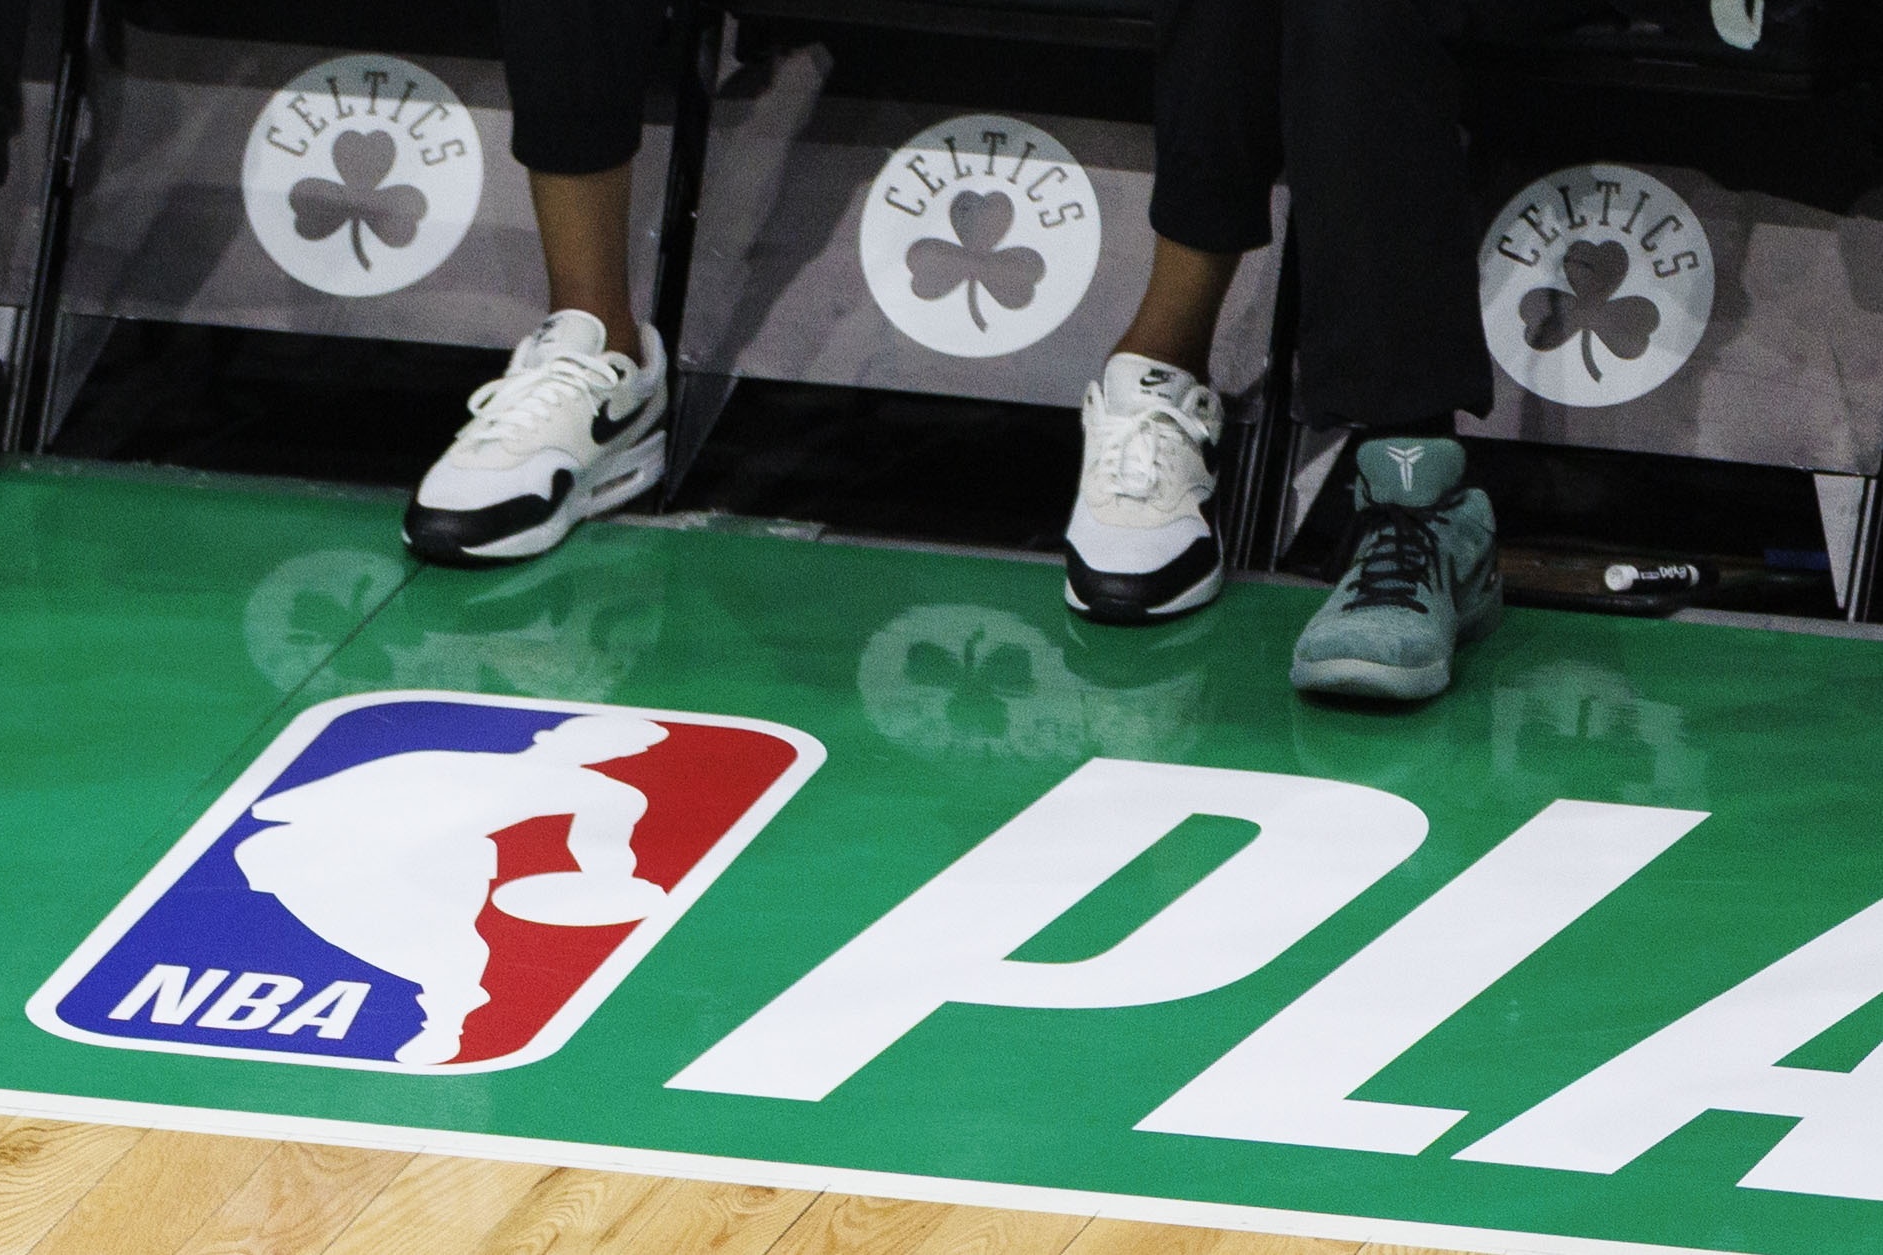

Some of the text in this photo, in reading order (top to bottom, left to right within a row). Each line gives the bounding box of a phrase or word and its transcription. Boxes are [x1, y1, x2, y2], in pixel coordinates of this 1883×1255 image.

[266, 70, 466, 166] CELTICS
[884, 130, 1085, 229] CELTICS
[1497, 180, 1700, 278] CELTICS
[107, 963, 373, 1040] NBA
